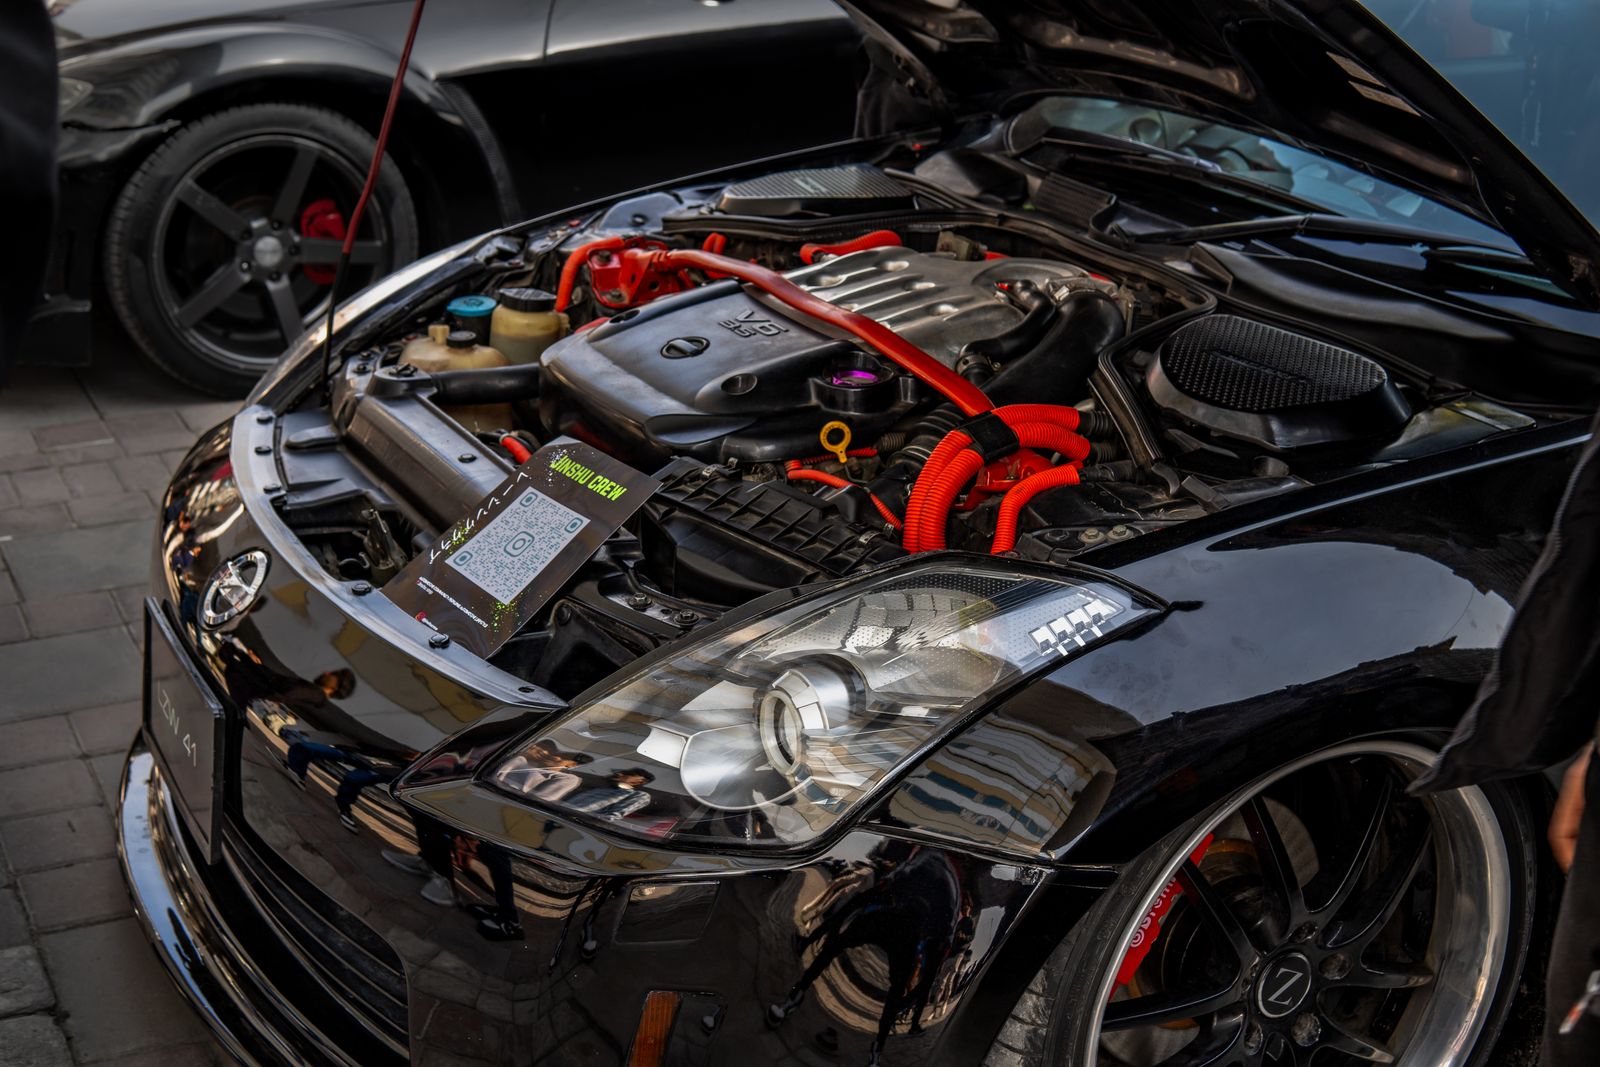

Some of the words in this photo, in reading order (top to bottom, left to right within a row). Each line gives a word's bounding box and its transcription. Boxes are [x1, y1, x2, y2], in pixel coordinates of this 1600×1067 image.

[736, 310, 788, 336] V6
[550, 455, 593, 485] JINSHU
[588, 473, 627, 501] CREW
[1267, 967, 1303, 1006] Z
